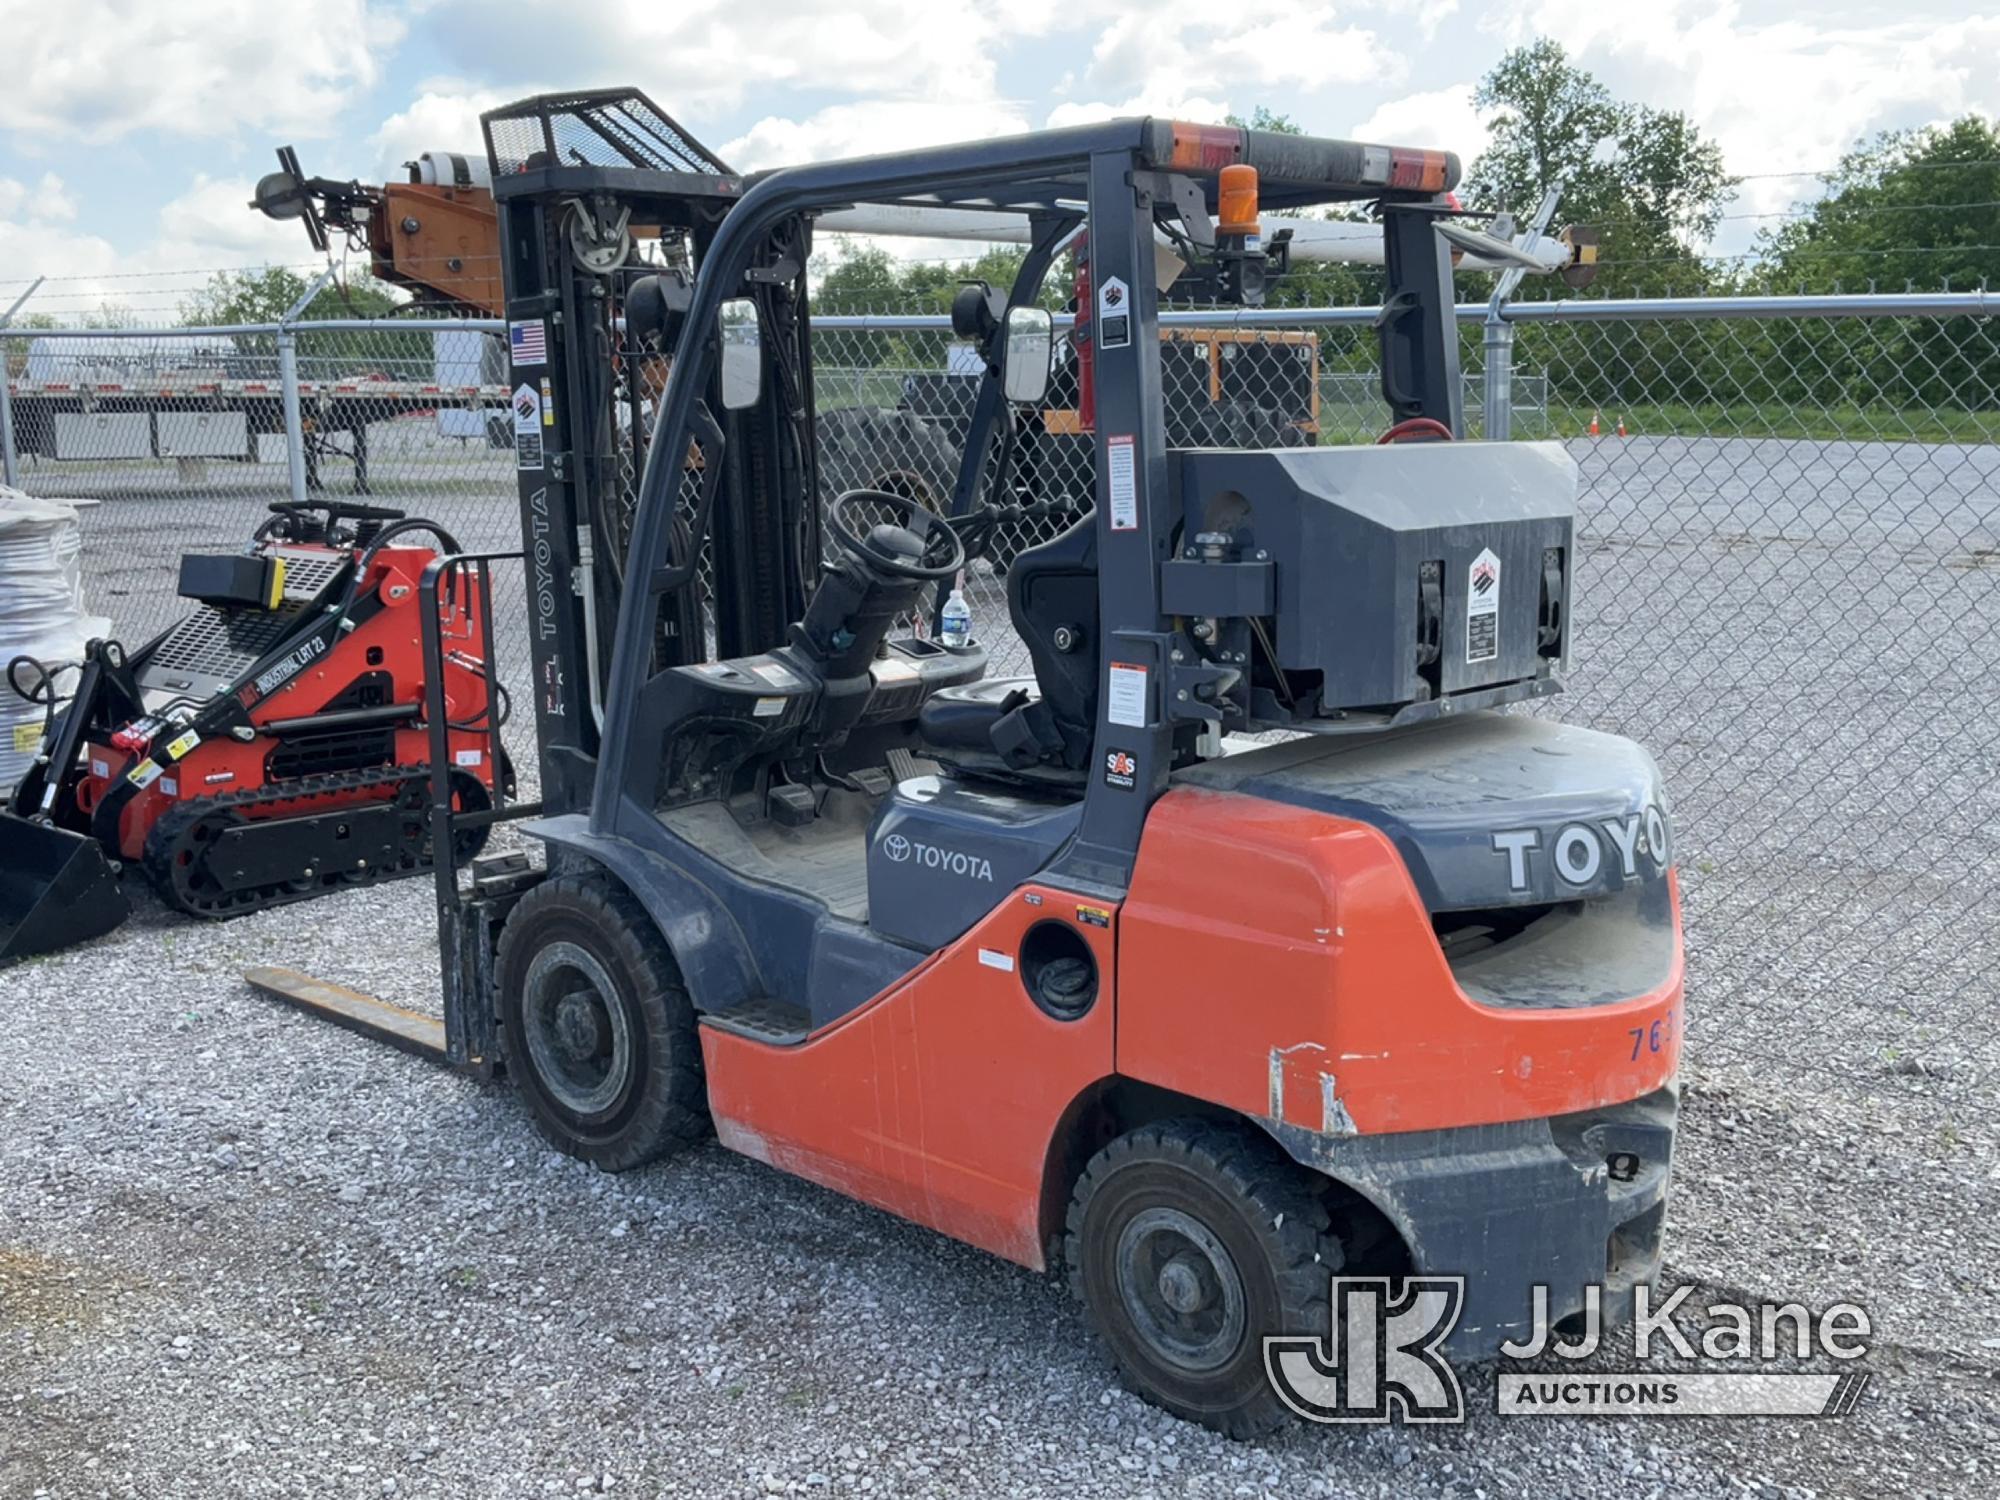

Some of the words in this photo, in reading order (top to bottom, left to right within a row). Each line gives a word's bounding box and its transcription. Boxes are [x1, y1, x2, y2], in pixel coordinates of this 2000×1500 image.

[76, 355, 149, 368] NEWMAN
[530, 487, 557, 641] TOYOTA
[256, 653, 301, 695] INDUSTRIAL
[295, 642, 315, 665] LRT
[311, 636, 326, 654] 23
[1107, 752, 1136, 775] SAS
[913, 843, 993, 882] TOYOTA
